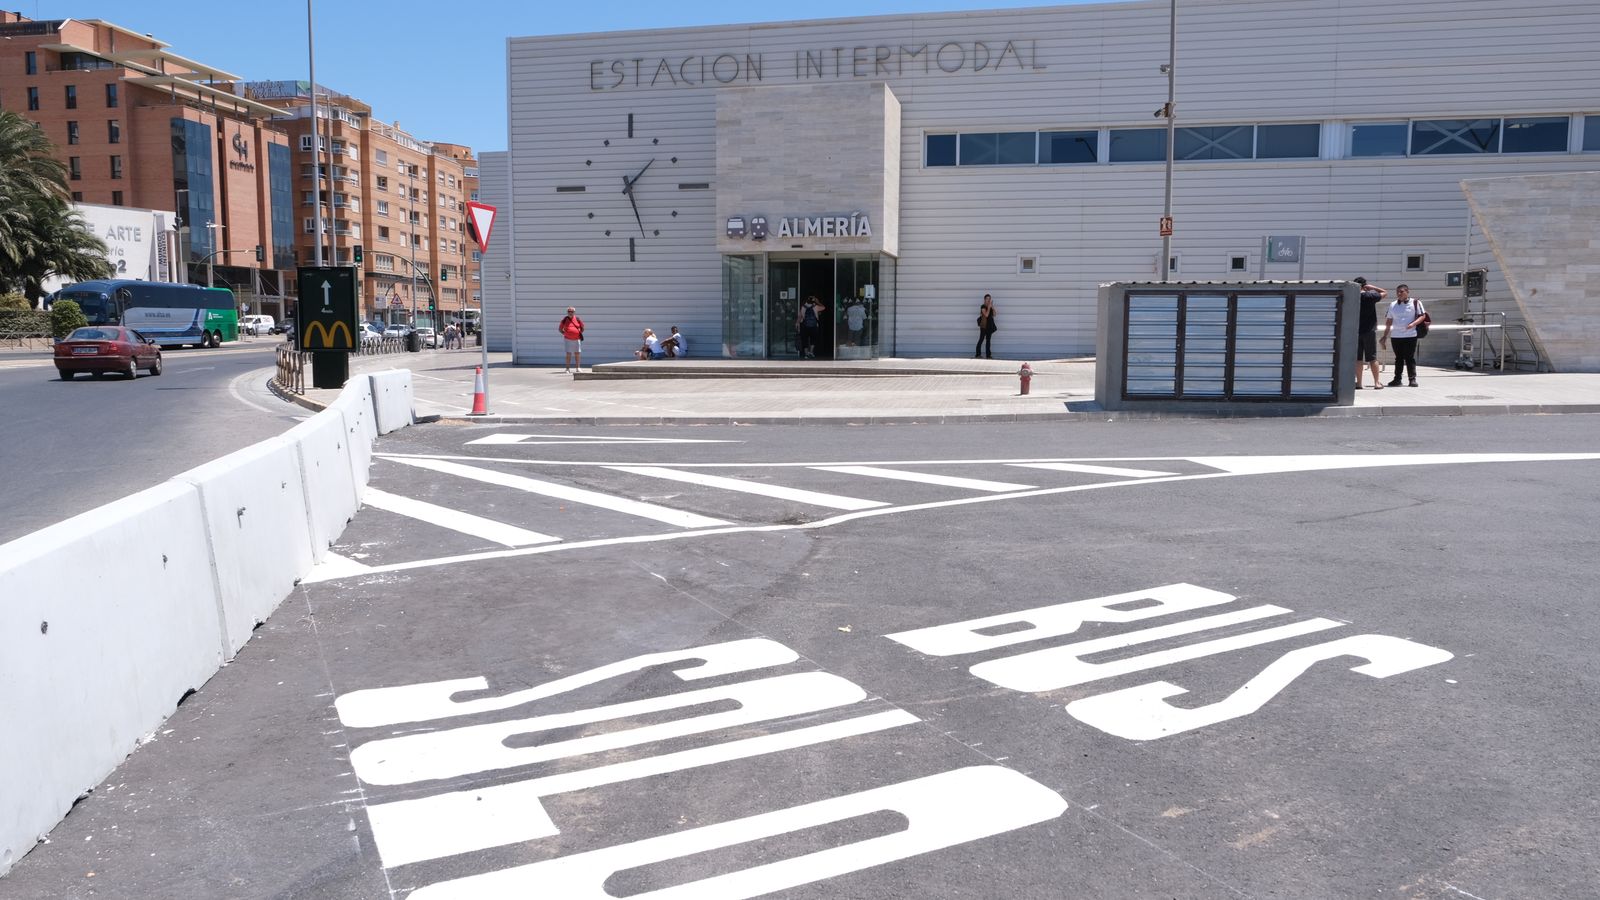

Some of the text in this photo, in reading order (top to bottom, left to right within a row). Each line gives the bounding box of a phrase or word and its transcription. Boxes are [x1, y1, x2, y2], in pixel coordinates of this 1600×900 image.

[590, 39, 1048, 90] ESTACION INTERMODAL
[105, 225, 141, 242] ARTE
[777, 211, 872, 237] ALMERÍA
[885, 582, 1454, 741] BUS
[336, 638, 1069, 900] SOLO
